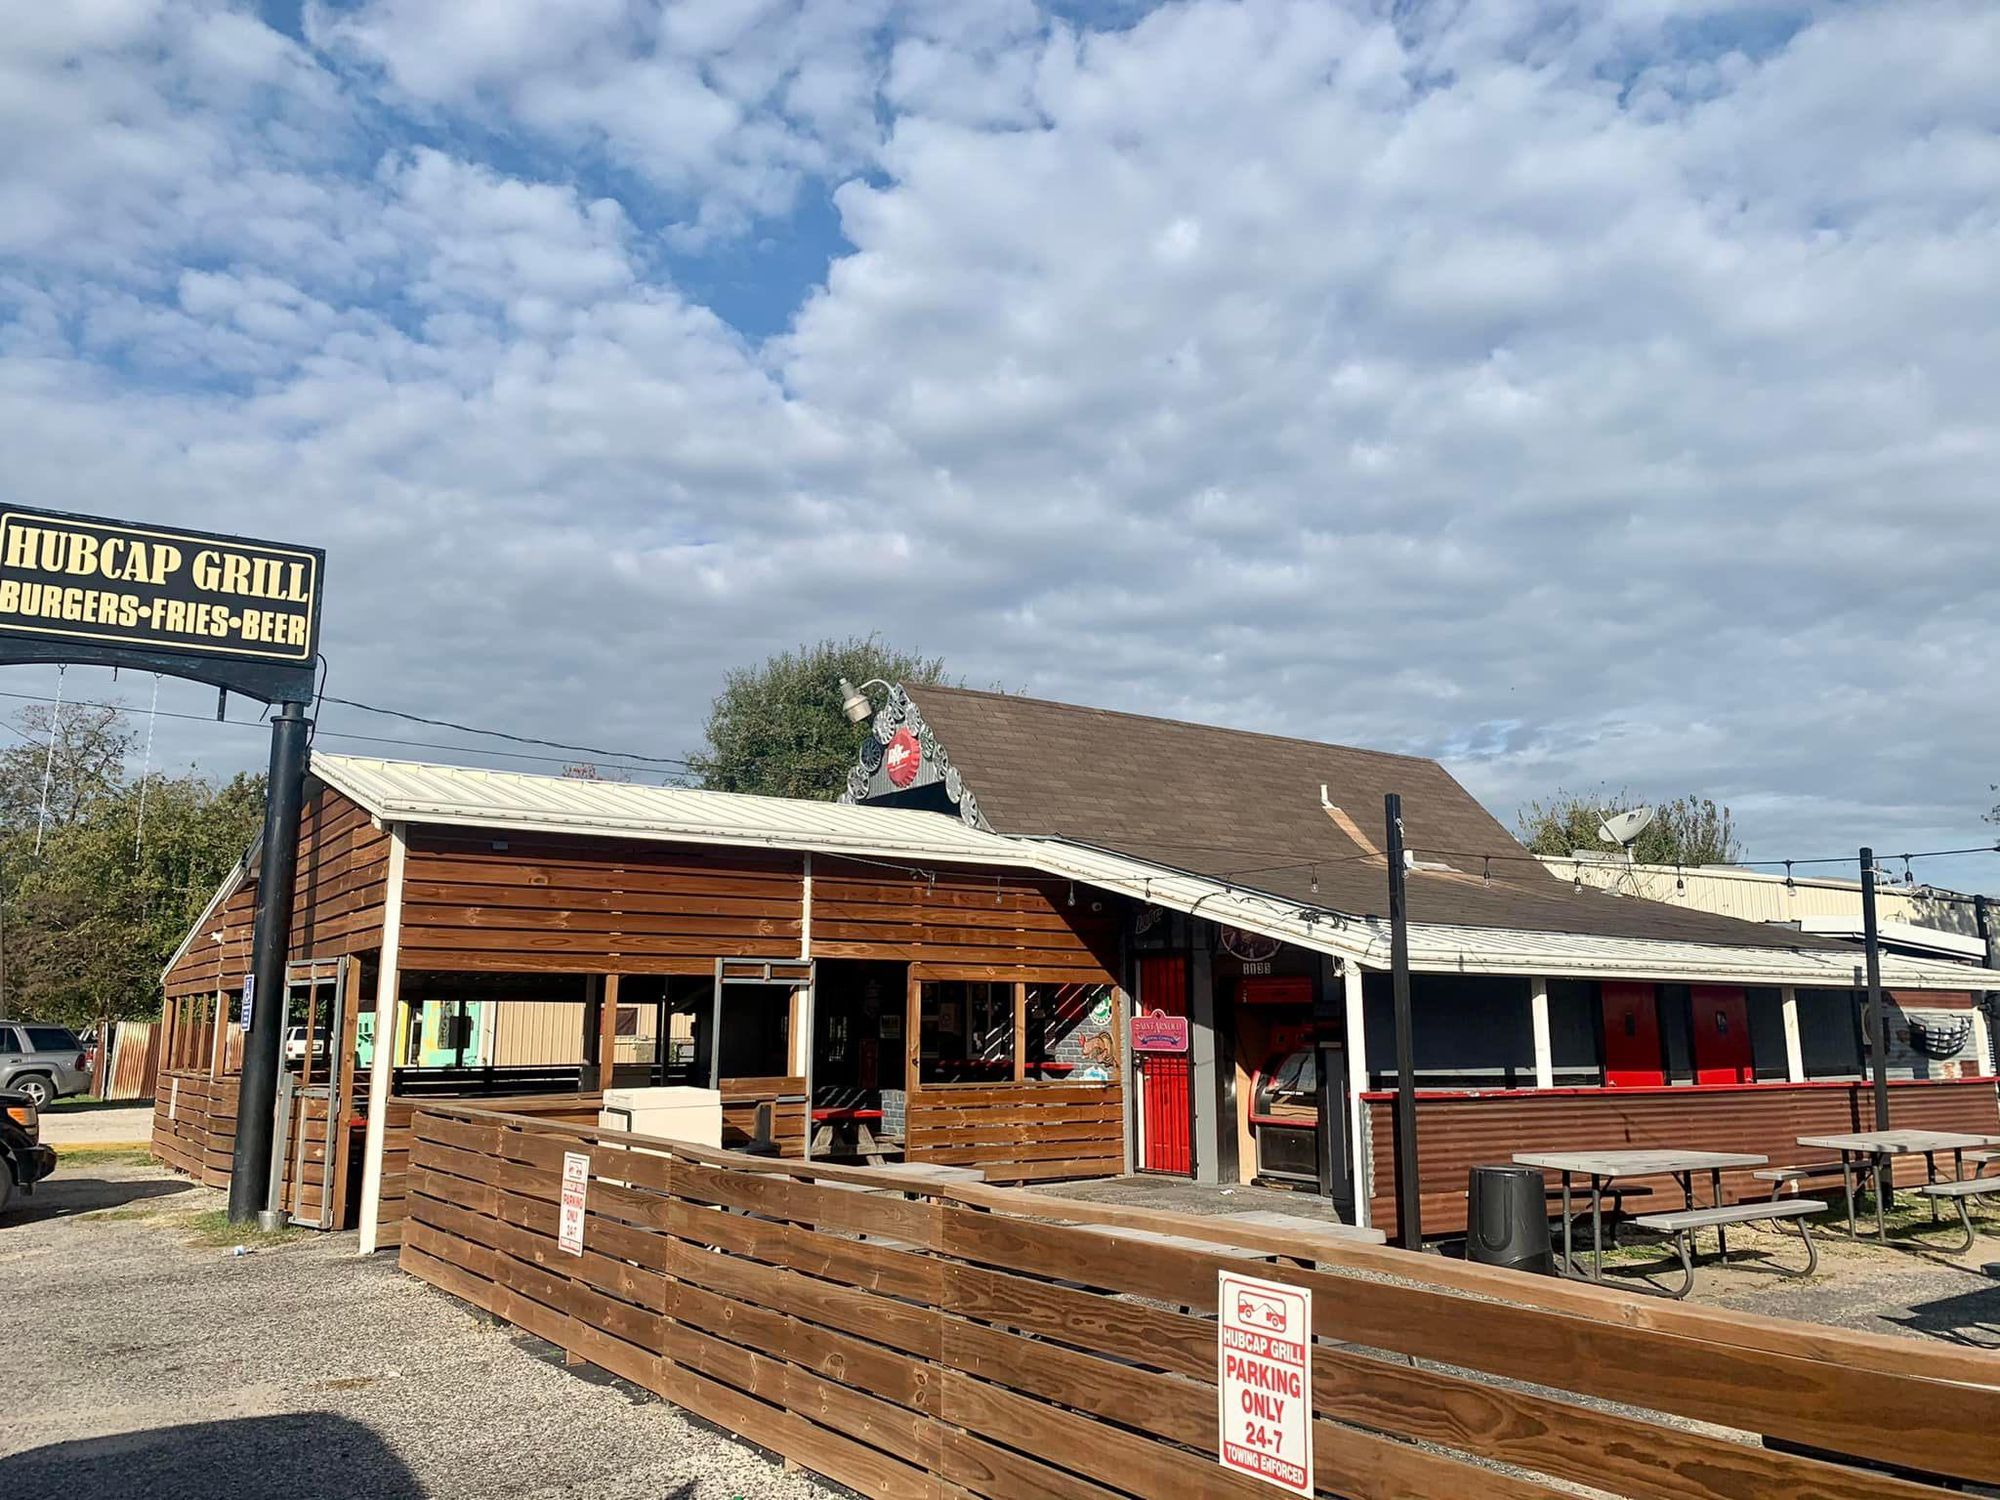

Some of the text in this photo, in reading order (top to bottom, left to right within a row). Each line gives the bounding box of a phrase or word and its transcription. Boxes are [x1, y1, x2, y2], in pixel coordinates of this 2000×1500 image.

[4, 525, 309, 603] HUBCAP GRILL
[0, 580, 306, 646] BURGERS FRIES BEER
[1223, 1330, 1304, 1362] HUBCAP GRILL
[1226, 1354, 1301, 1399] PARKING
[1241, 1388, 1285, 1424] ONLY
[1245, 1421, 1283, 1454] 24-7
[1226, 1443, 1259, 1469] TOWING
